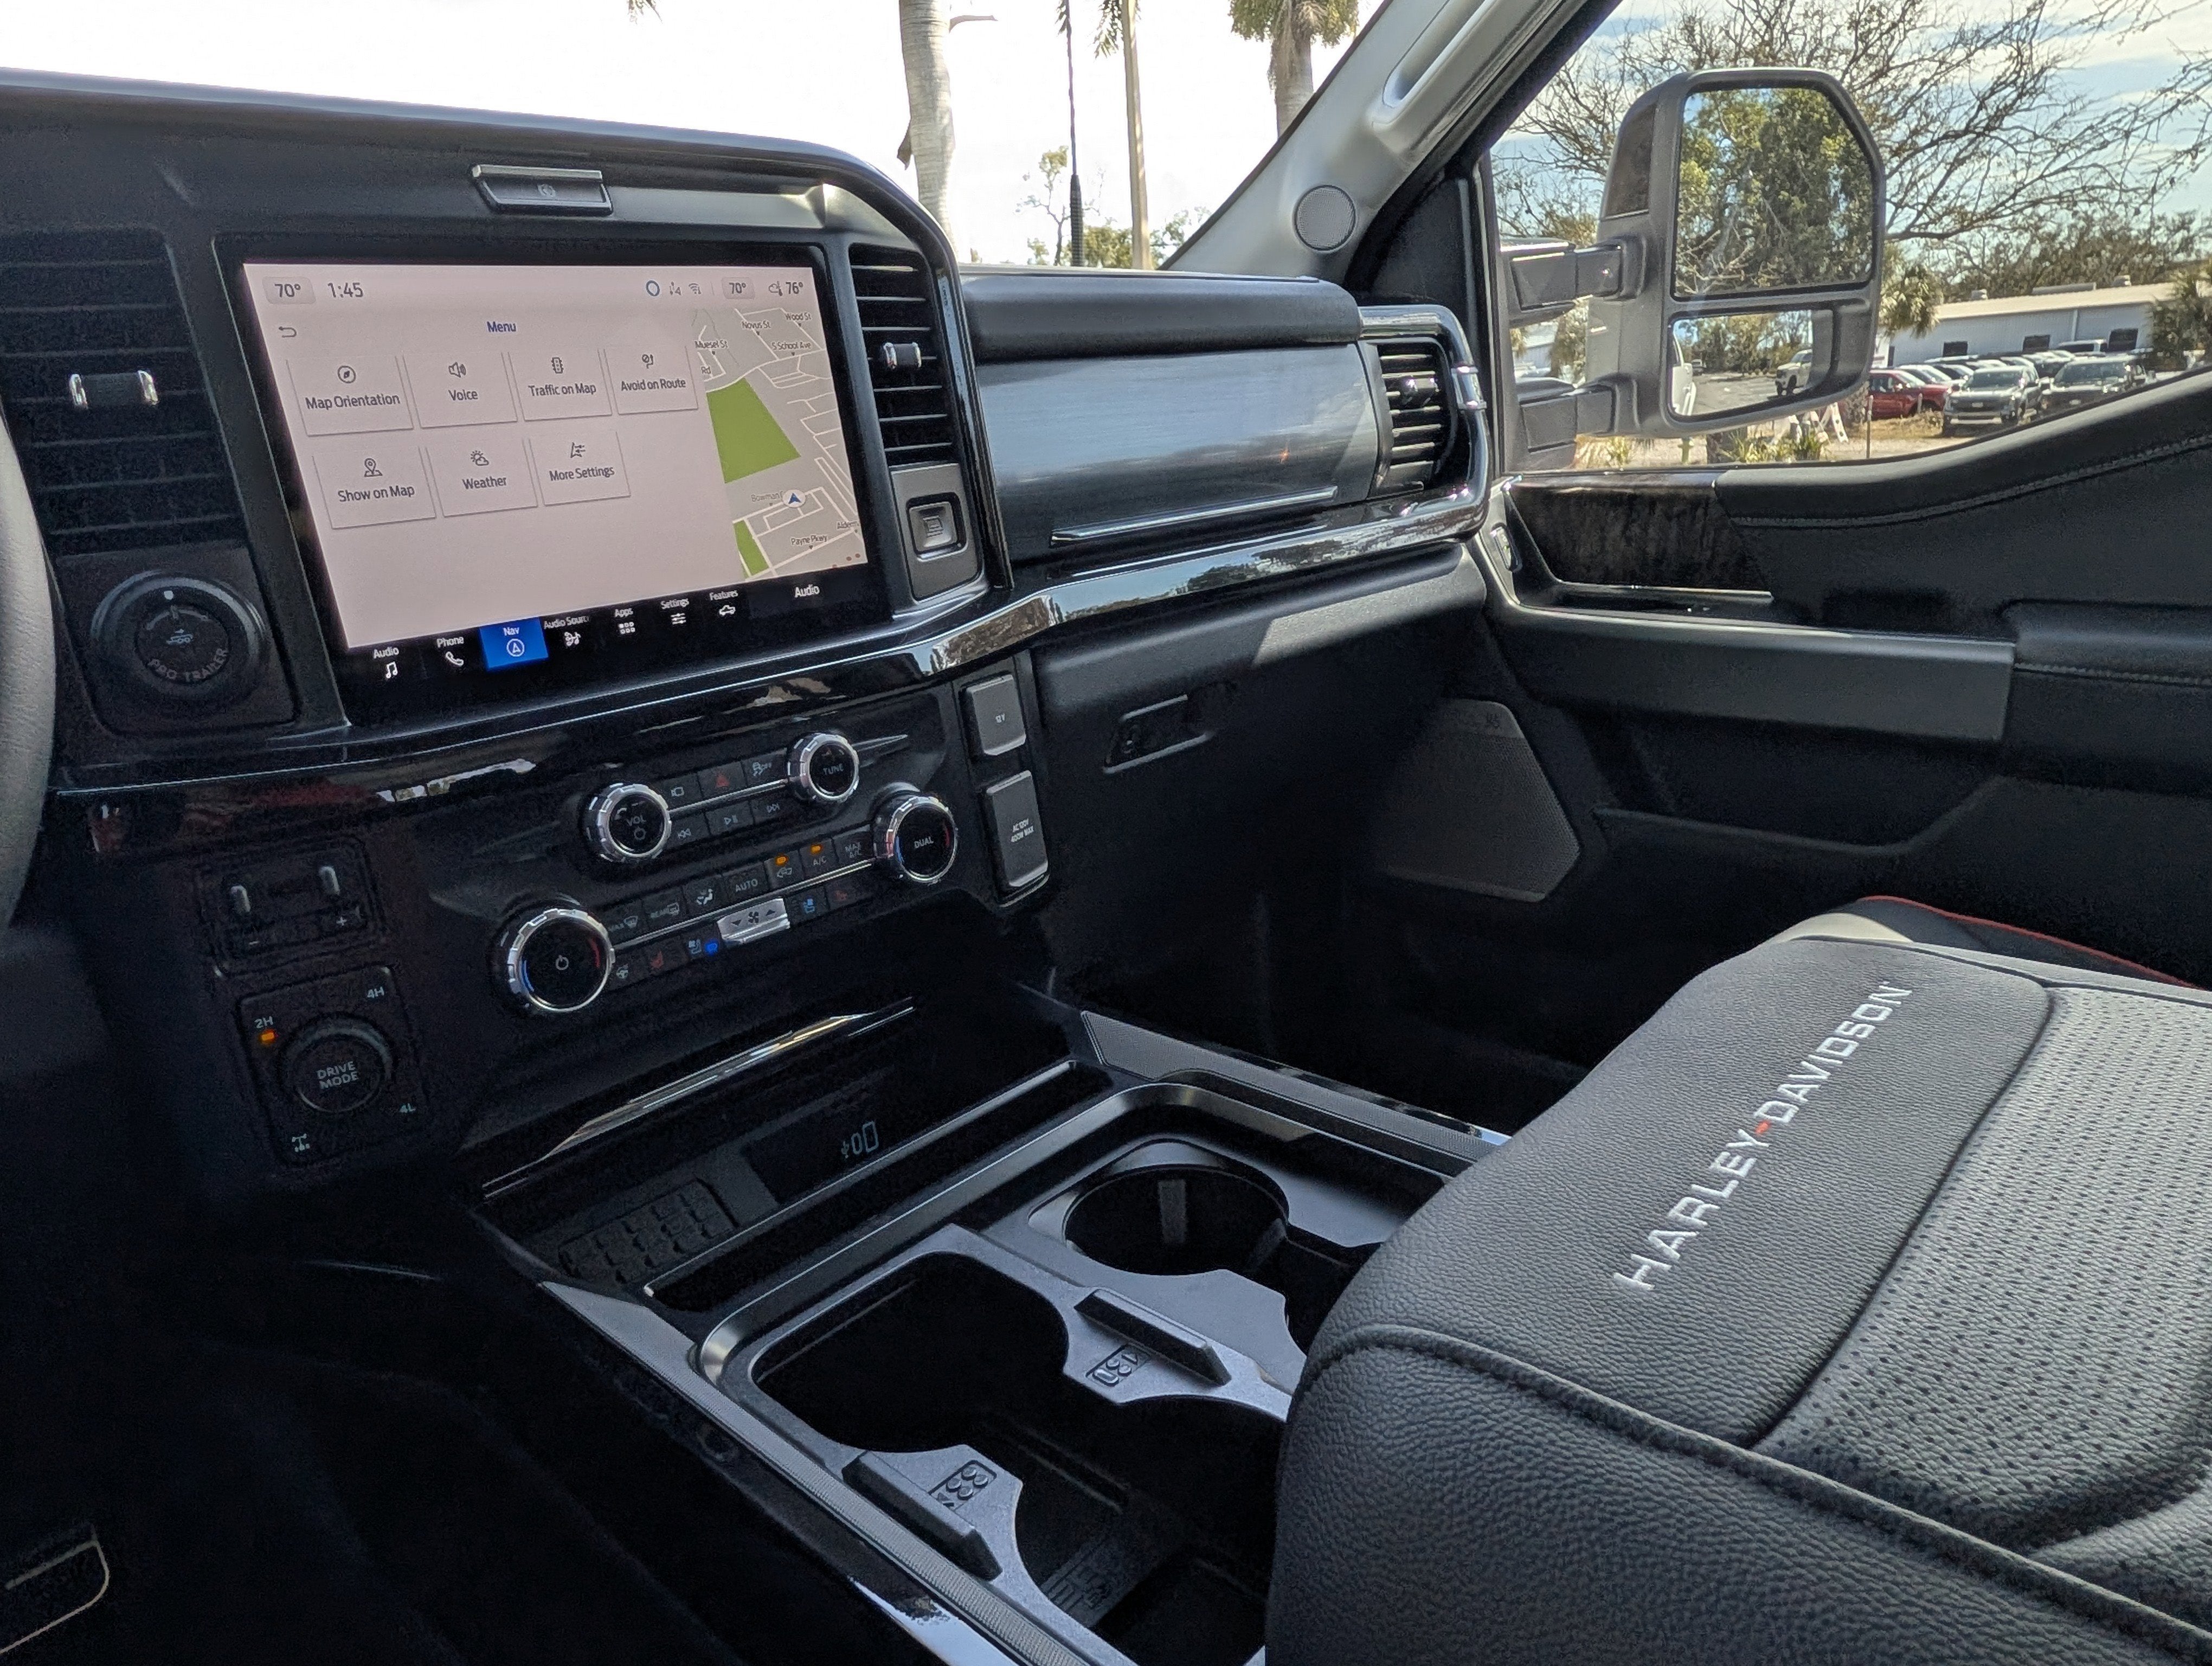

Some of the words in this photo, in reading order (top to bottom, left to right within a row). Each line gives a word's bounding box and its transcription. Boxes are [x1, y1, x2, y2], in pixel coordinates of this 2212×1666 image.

[274, 283, 301, 298] 70°
[328, 283, 364, 298] 1:45
[729, 282, 747, 294] 70°
[786, 281, 803, 294] 76°
[804, 312, 812, 320] St
[487, 321, 516, 332] Menu
[763, 320, 770, 328] St
[528, 385, 559, 396] Traffic
[562, 386, 574, 394] on
[576, 383, 596, 395] Map
[621, 379, 646, 391] Avoid
[648, 381, 659, 389] on
[660, 379, 686, 389] Route
[448, 389, 478, 401] Voice
[306, 397, 332, 410] Map
[334, 394, 400, 408] Orientation
[549, 470, 574, 481] More
[575, 466, 615, 479] Settings
[462, 476, 507, 490] Weather
[338, 489, 371, 502] Show
[373, 489, 389, 498] on
[389, 485, 415, 498] Map
[791, 536, 810, 546] Payne
[811, 534, 827, 542] Pkwy
[709, 589, 738, 601] Features
[794, 585, 820, 598] Audio
[660, 598, 690, 610] Settings
[614, 607, 634, 618] Apps
[543, 617, 565, 630] Audio
[503, 626, 520, 636] Nav
[436, 636, 465, 649] Phone
[373, 646, 400, 659] Audio
[823, 763, 844, 776] TUNE
[626, 815, 646, 826] VOL
[914, 837, 934, 849] DUAL
[735, 878, 758, 893] AUTO
[366, 987, 384, 998] 4H
[254, 1016, 273, 1029] 2H
[317, 1061, 356, 1079] DRIVE
[319, 1071, 359, 1090] MODE
[399, 1104, 416, 1113] 4L
[1613, 984, 1912, 1290] HARLEY-DAVIDSON
